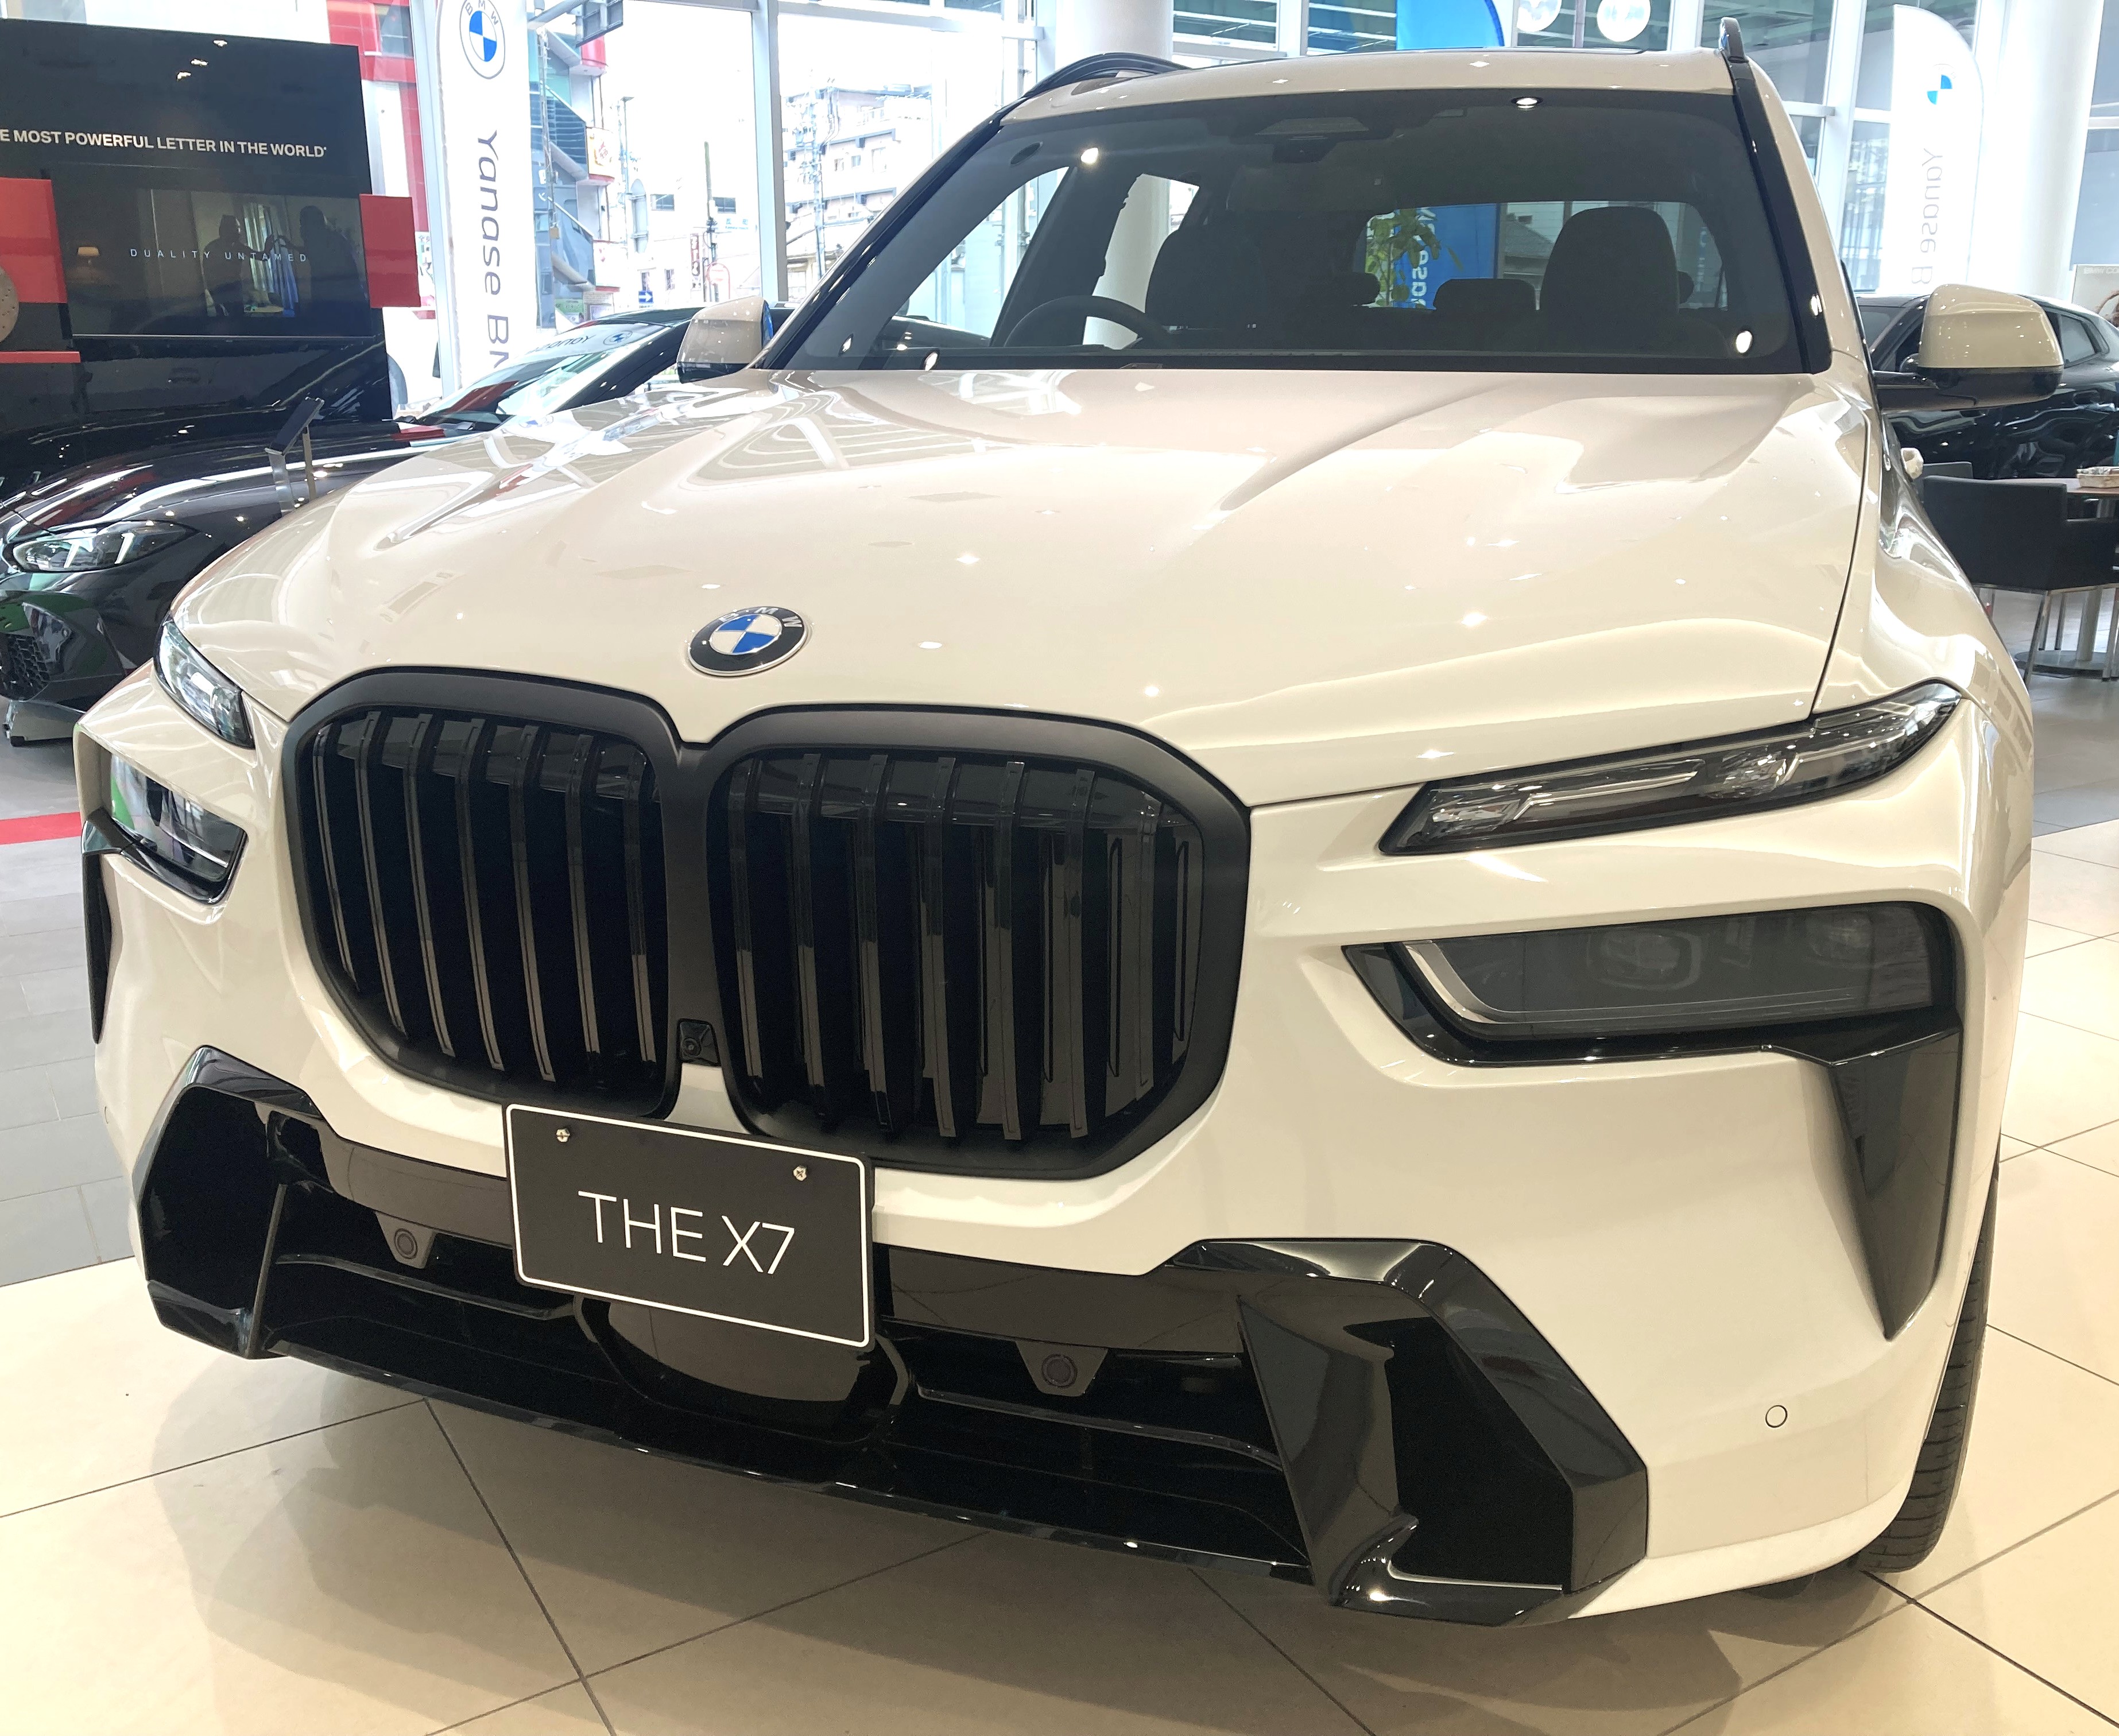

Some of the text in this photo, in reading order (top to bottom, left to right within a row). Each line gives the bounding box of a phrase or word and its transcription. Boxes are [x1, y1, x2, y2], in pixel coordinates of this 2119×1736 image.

[14, 130, 61, 144] MOST
[65, 132, 154, 149] POWERFUL
[157, 137, 216, 152] LETTER
[219, 141, 235, 153] IN
[237, 141, 268, 154] THE
[477, 129, 501, 295] Yanase
[130, 248, 307, 262] DUALITY UNTAMED
[718, 607, 803, 627] BMW
[578, 1191, 795, 1275] THE X7
